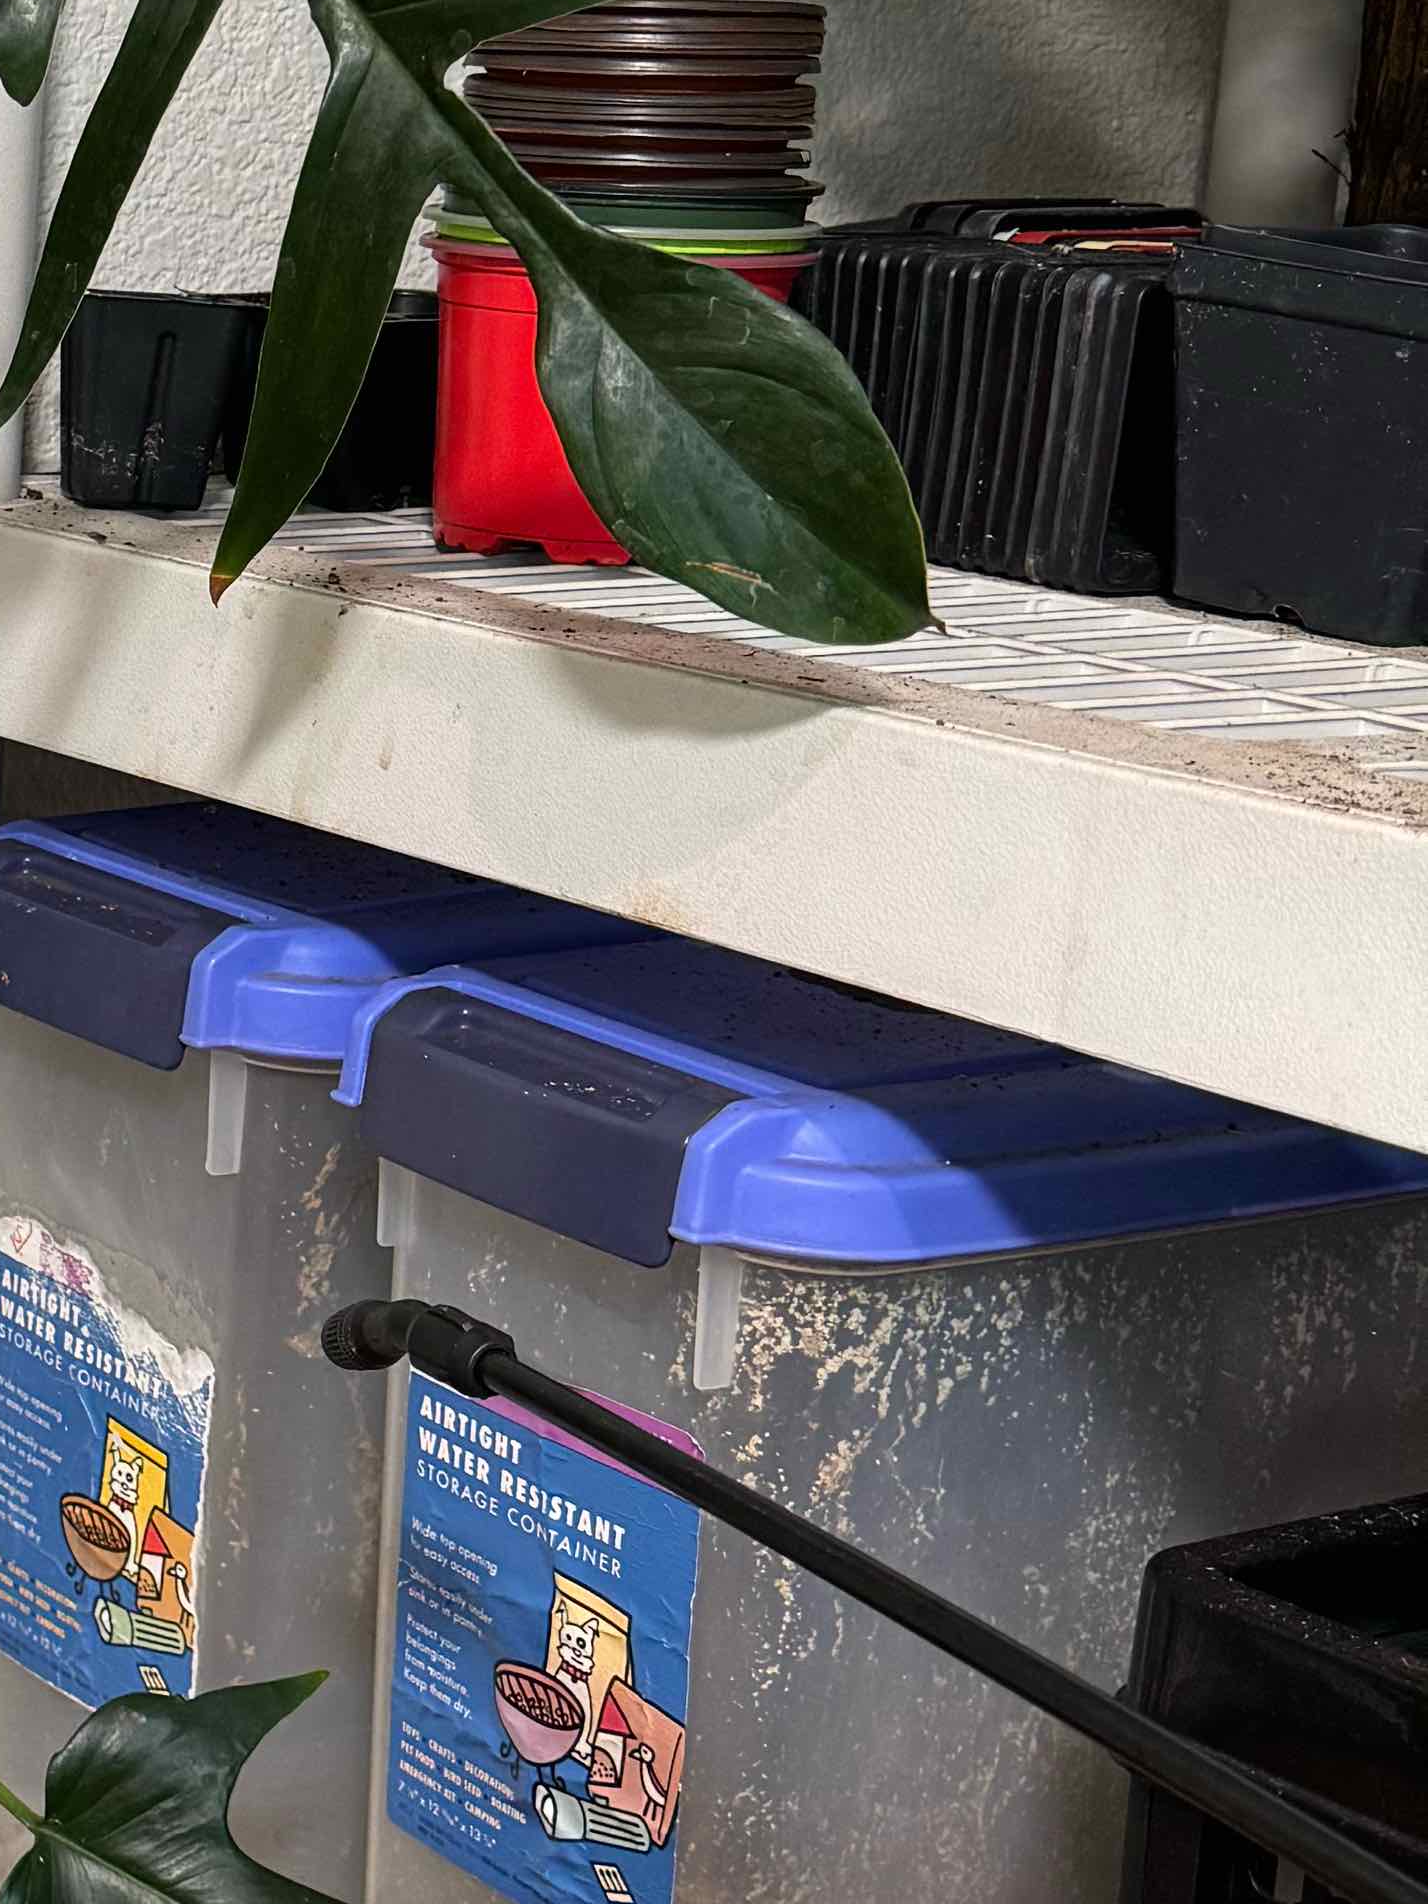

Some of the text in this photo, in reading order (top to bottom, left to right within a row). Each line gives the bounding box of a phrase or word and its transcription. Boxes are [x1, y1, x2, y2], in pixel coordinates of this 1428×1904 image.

[0, 1295, 56, 1345] WATER
[419, 1394, 522, 1465] AIRTIGHT
[416, 1459, 622, 1578] STORAGE CONTAINER
[418, 1426, 626, 1551] WATER RESISTANT
[458, 1545, 498, 1577] opening
